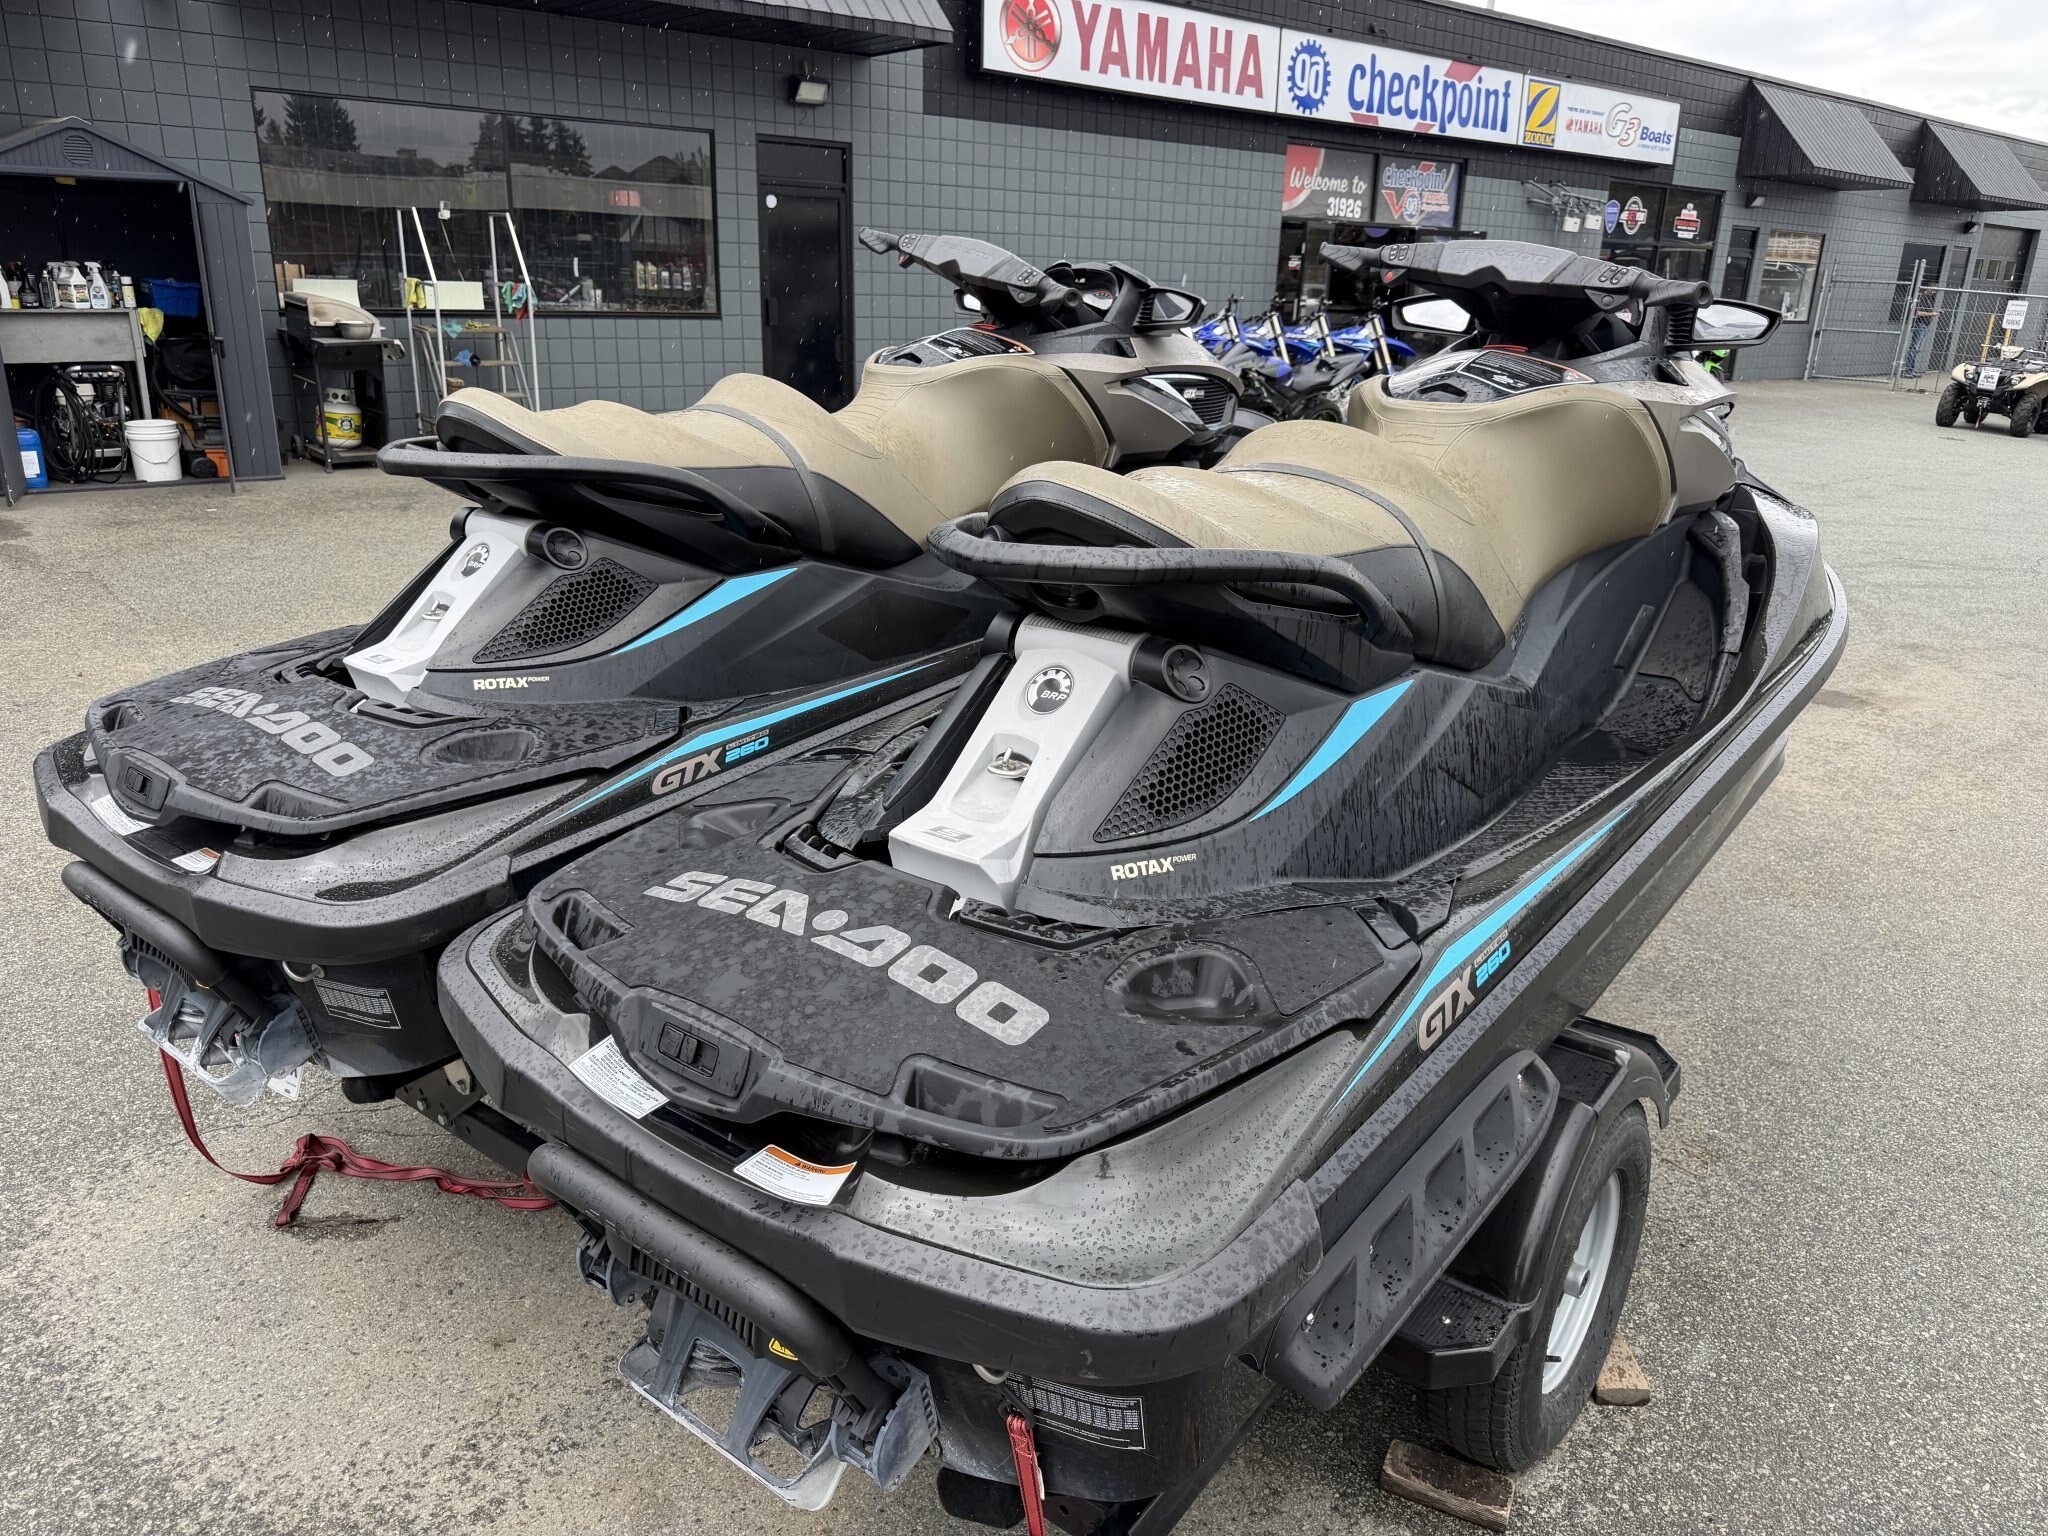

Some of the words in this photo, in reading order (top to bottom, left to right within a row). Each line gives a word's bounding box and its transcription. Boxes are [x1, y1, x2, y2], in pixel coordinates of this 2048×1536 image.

[1072, 0, 1263, 99] YAMAHA
[1348, 53, 1511, 133] checkpoint
[1525, 132, 1555, 146] ZODIAC
[1574, 119, 1603, 136] YAMAHA
[1640, 126, 1673, 145] Boats
[1290, 167, 1349, 192] Welcome
[1352, 176, 1367, 194] to
[1383, 163, 1447, 191] checkpoint
[1326, 197, 1362, 218] 31926
[473, 676, 529, 690] ROTAX
[1040, 690, 1067, 701] BRP
[651, 747, 723, 795] GTX
[725, 736, 769, 763] 260
[1110, 857, 1175, 881] ROTAX
[1172, 853, 1197, 863] POWER
[1474, 930, 1508, 968] LIMITED
[1418, 965, 1475, 1051] GTX
[1476, 940, 1510, 988] 260
